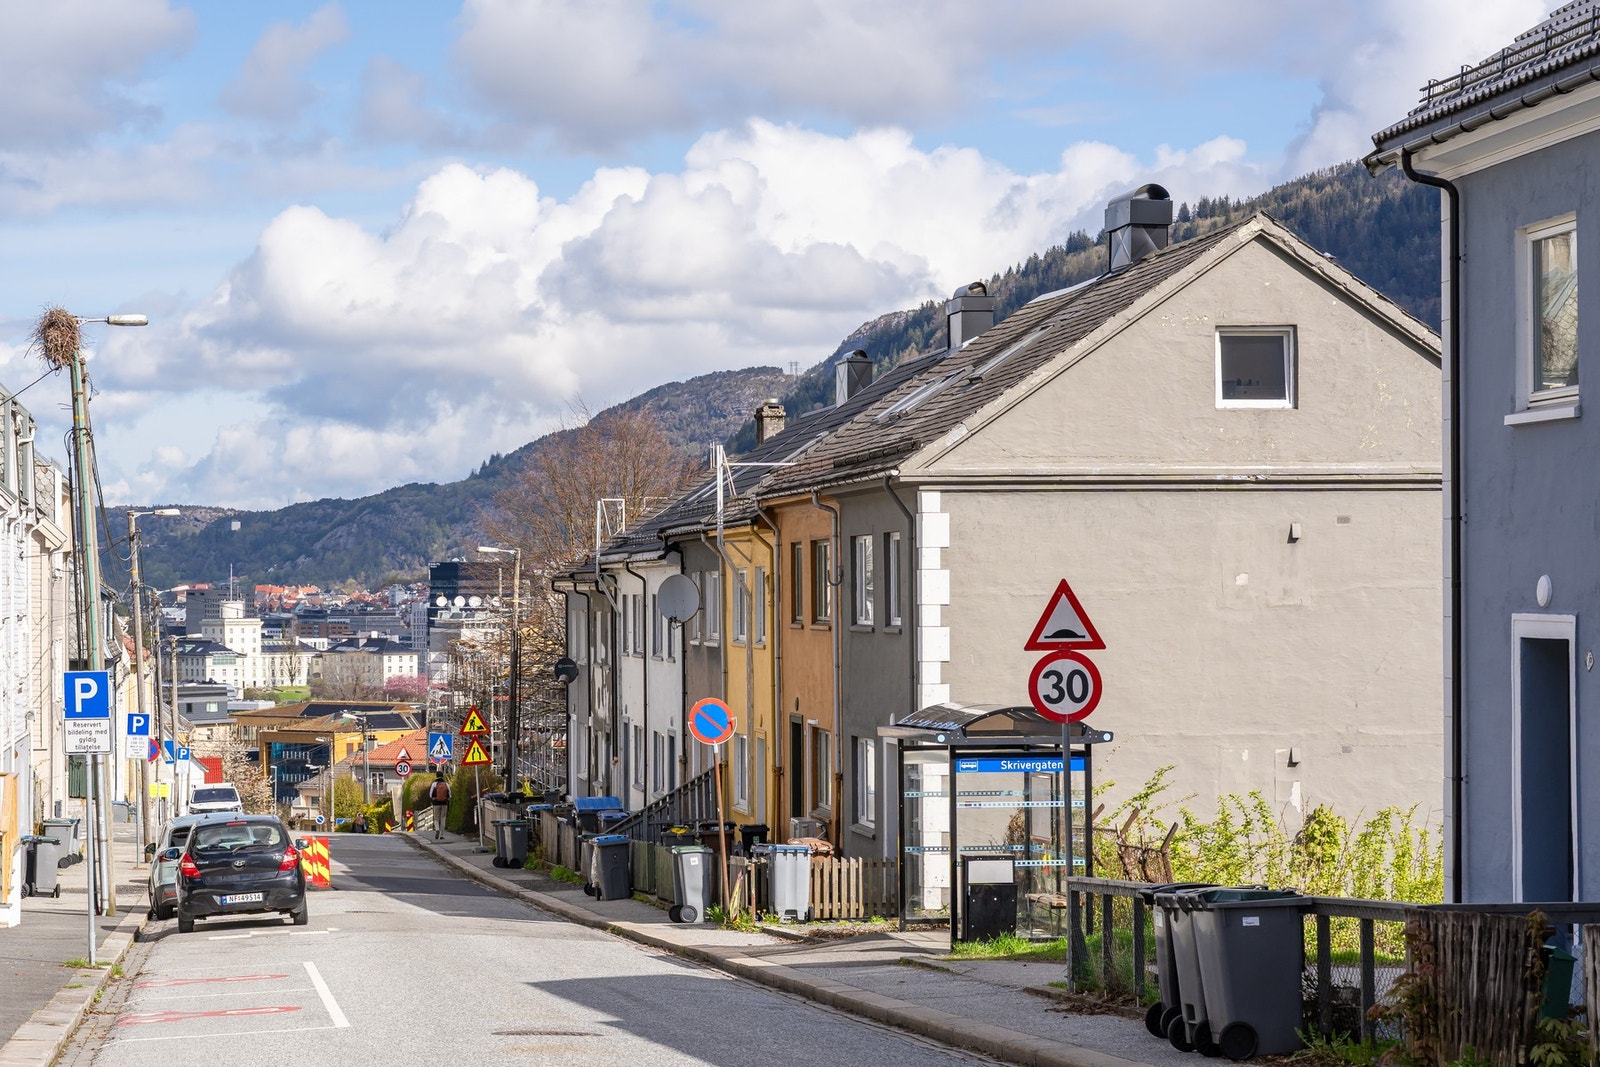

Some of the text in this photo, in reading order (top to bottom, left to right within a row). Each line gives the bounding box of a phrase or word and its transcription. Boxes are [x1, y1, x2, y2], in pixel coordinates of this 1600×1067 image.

[1042, 669, 1089, 704] 30
[75, 678, 98, 712] P
[132, 716, 145, 733] P
[180, 750, 188, 760] P
[398, 764, 409, 773] 30
[1000, 760, 1064, 772] Skrivergaten
